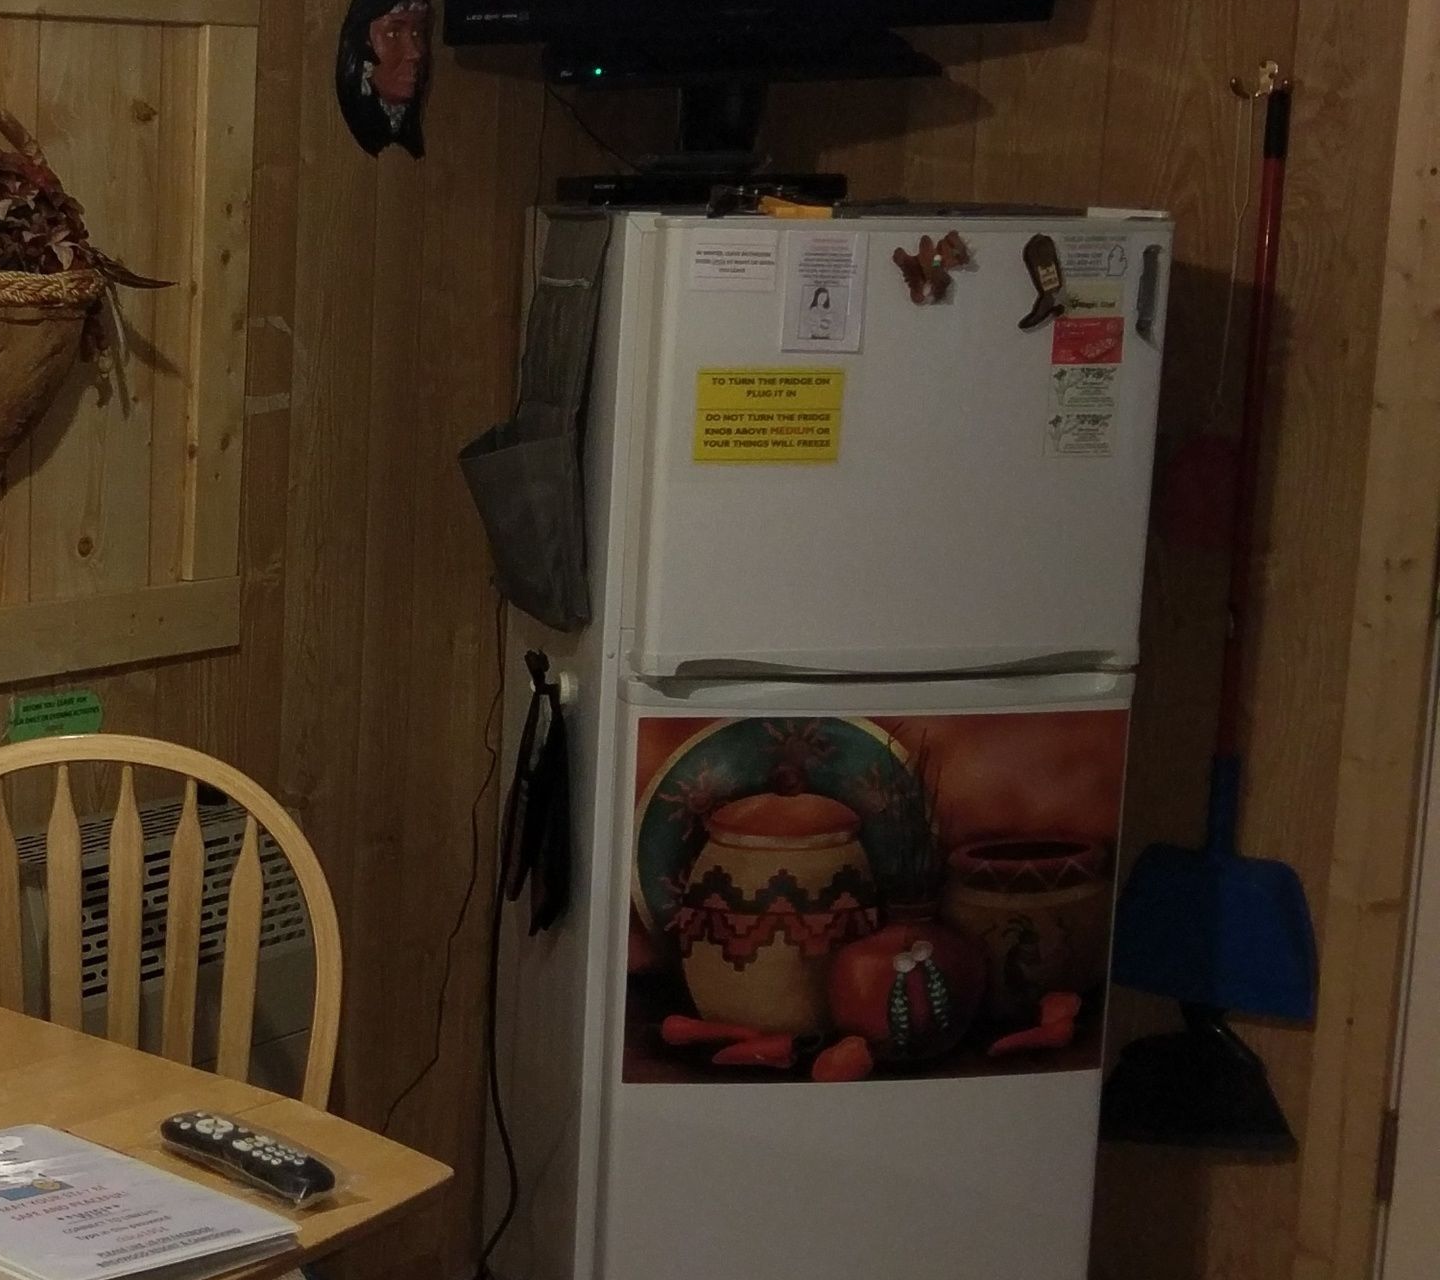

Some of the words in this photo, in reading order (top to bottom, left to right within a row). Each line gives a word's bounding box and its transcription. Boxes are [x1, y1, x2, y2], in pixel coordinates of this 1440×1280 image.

[712, 377, 725, 386] TO
[729, 377, 755, 386] TURN
[758, 377, 776, 386] THE
[779, 377, 813, 386] FRIDGE
[815, 377, 831, 386] ON
[746, 389, 771, 398] PLUG
[773, 389, 783, 398] IT
[786, 389, 796, 398] IN
[705, 413, 720, 422] DO
[723, 413, 744, 422] NOT
[748, 413, 774, 422] TURN
[777, 413, 795, 422] THE
[798, 413, 831, 422] FRIDGE
[704, 427, 732, 436] KNOB
[735, 427, 767, 436] ABOVE
[770, 427, 814, 436] MEDIUM
[816, 427, 830, 436] OR
[703, 439, 730, 448] YOUR
[734, 439, 769, 448] THINGS
[771, 439, 794, 448] WILL
[797, 439, 831, 448] FREEZE
